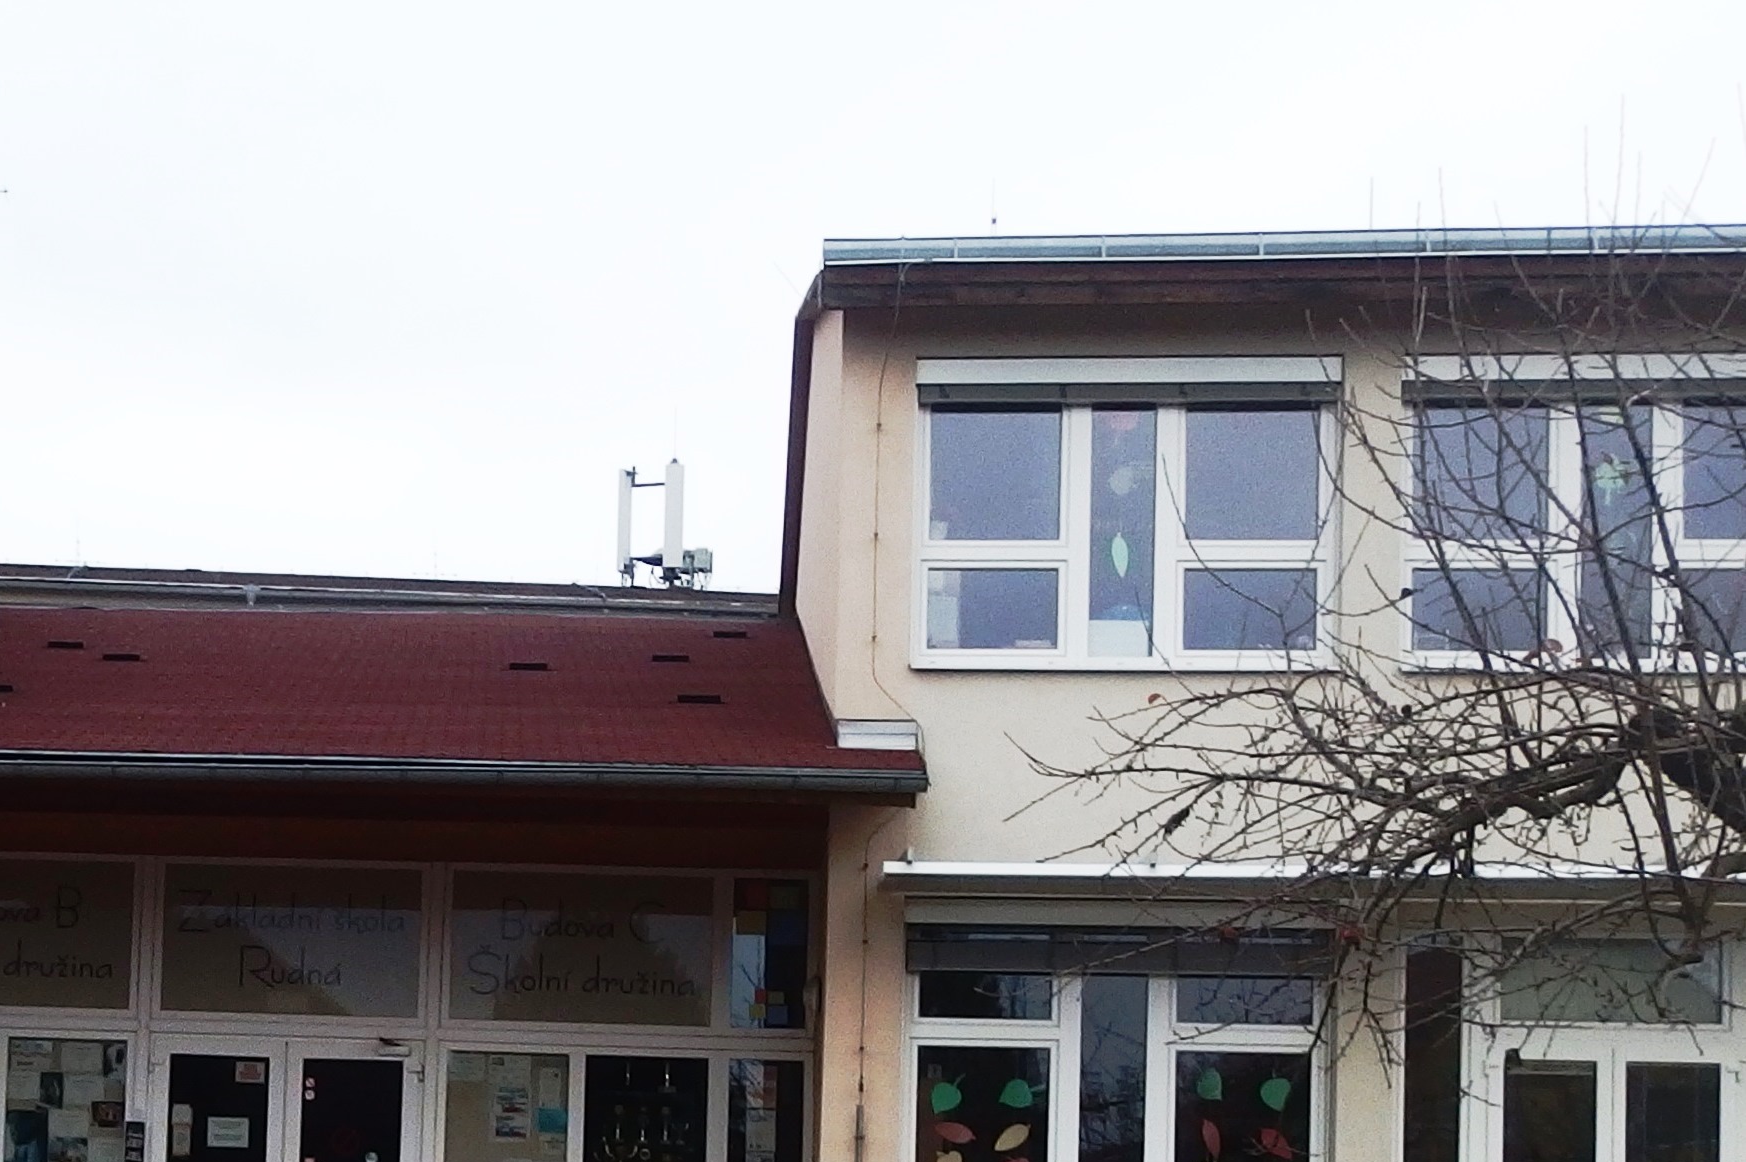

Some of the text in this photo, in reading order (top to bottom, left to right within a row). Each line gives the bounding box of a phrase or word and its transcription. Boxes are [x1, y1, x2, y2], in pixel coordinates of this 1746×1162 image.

[56, 884, 82, 928] B
[501, 896, 665, 944] Budova C
[3, 937, 112, 979] družina
[239, 944, 341, 988] Rudná
[468, 944, 695, 996] Školní družina
